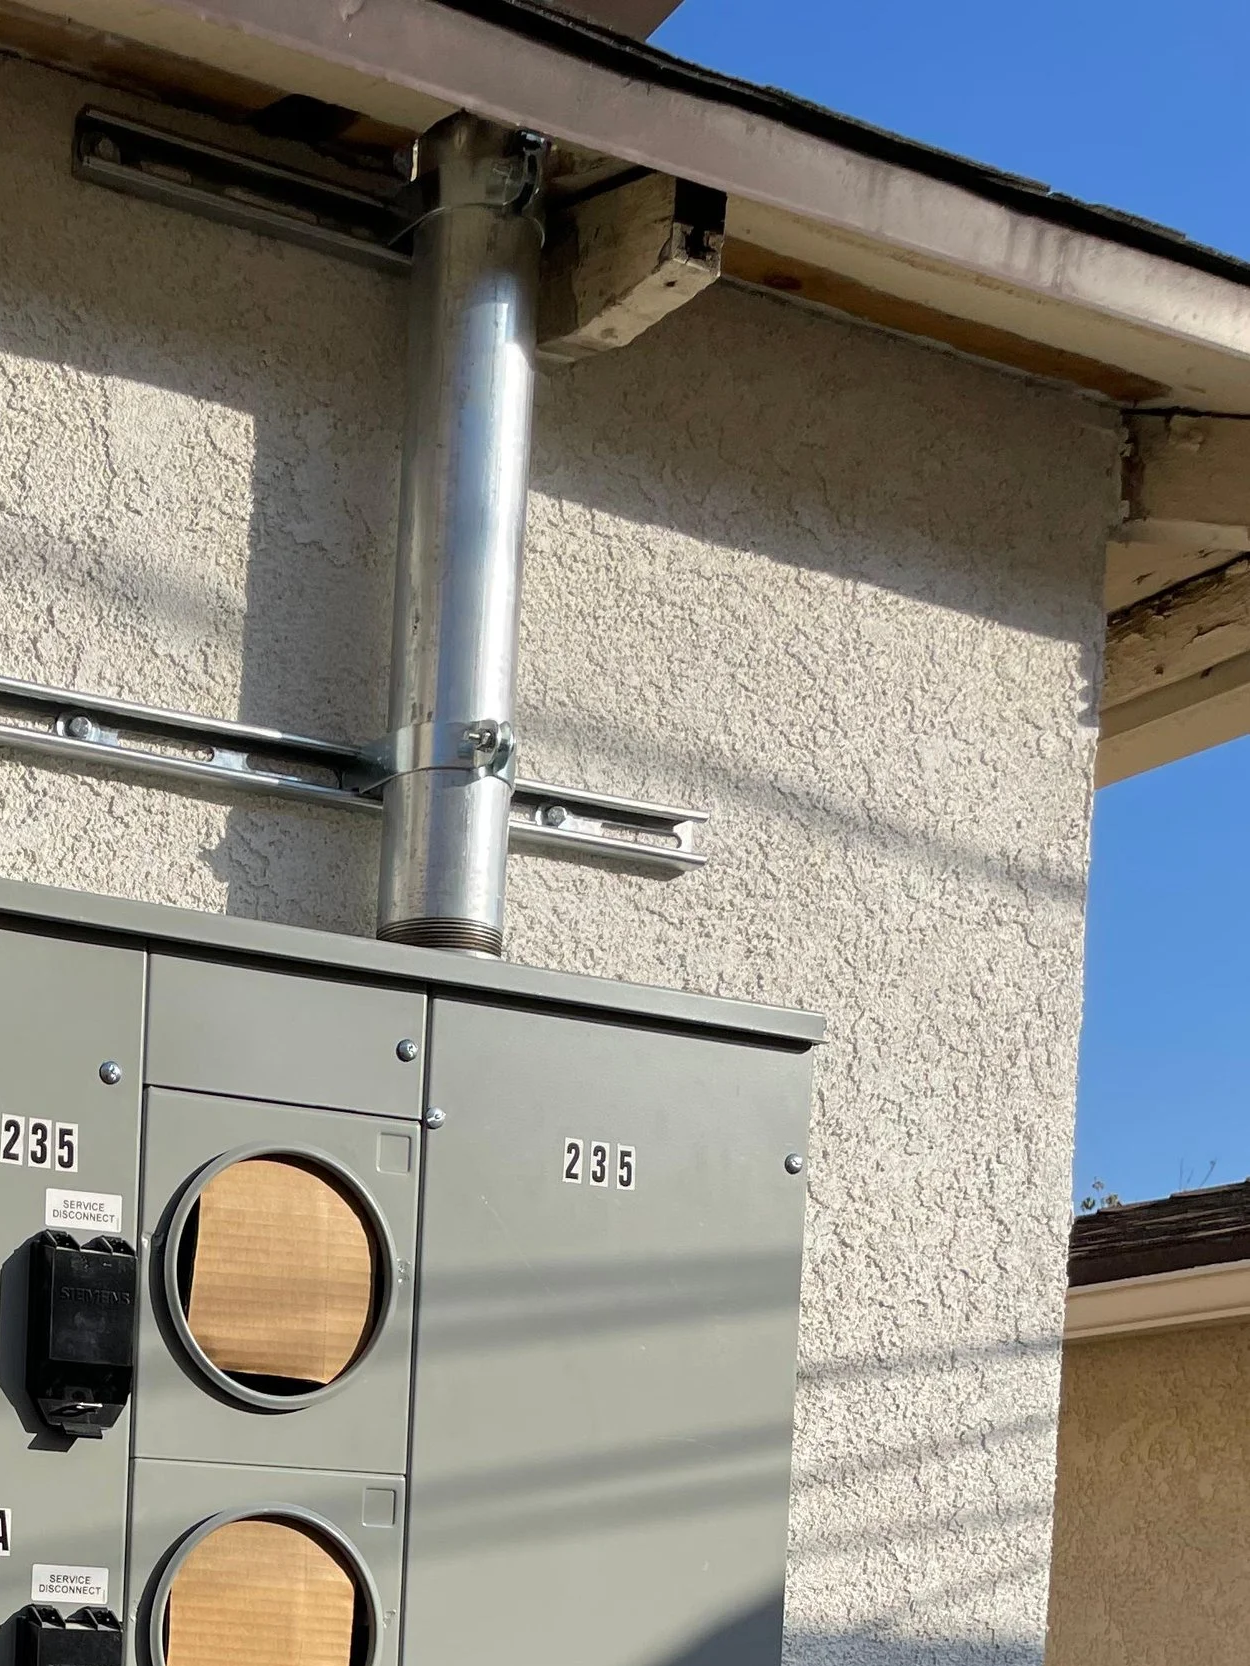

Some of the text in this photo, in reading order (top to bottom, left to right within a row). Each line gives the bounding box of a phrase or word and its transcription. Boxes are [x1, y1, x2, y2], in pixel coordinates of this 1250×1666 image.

[2, 1119, 75, 1169] 235
[565, 1142, 632, 1187] 235
[62, 1199, 105, 1212] SERVICE
[52, 1209, 115, 1223] DISCONNECT
[60, 1286, 130, 1305] SIEMENS
[49, 1574, 91, 1585] SERVICE
[38, 1584, 101, 1596] DISCONNECT
